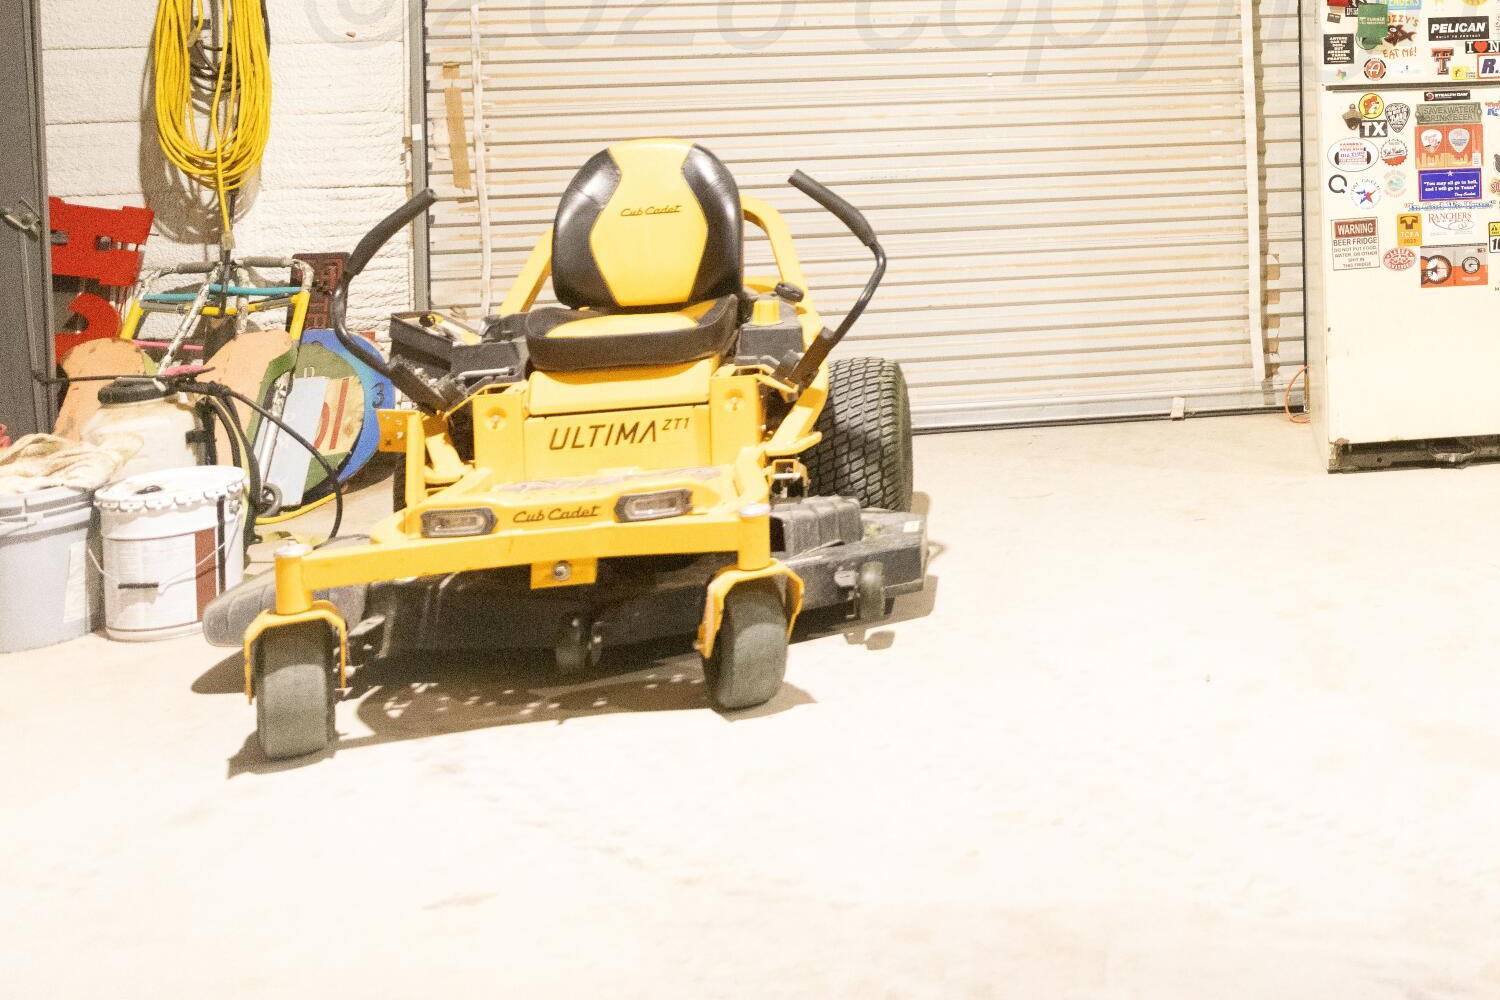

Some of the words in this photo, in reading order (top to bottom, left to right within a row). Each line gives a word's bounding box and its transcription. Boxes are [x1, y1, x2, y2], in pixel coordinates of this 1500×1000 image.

[1431, 22, 1486, 34] PELICAN
[1383, 49, 1399, 58] EAT
[1402, 47, 1417, 57] ME!
[1466, 41, 1474, 53] I
[1424, 107, 1441, 115] SAVE
[1446, 106, 1475, 114] WATER
[1451, 113, 1473, 121] BEER
[1361, 121, 1386, 137] TX
[620, 207, 643, 216] Cub
[645, 204, 681, 215] Cadet
[1429, 212, 1472, 223] RANCHERS
[1337, 222, 1374, 235] WARNING
[1333, 239, 1352, 247] BEER
[1352, 236, 1378, 245] FRIDGE
[549, 420, 657, 450] ULTIMA
[661, 417, 690, 431] ZT1
[512, 508, 544, 523] Cub
[547, 505, 601, 521] Cadet
